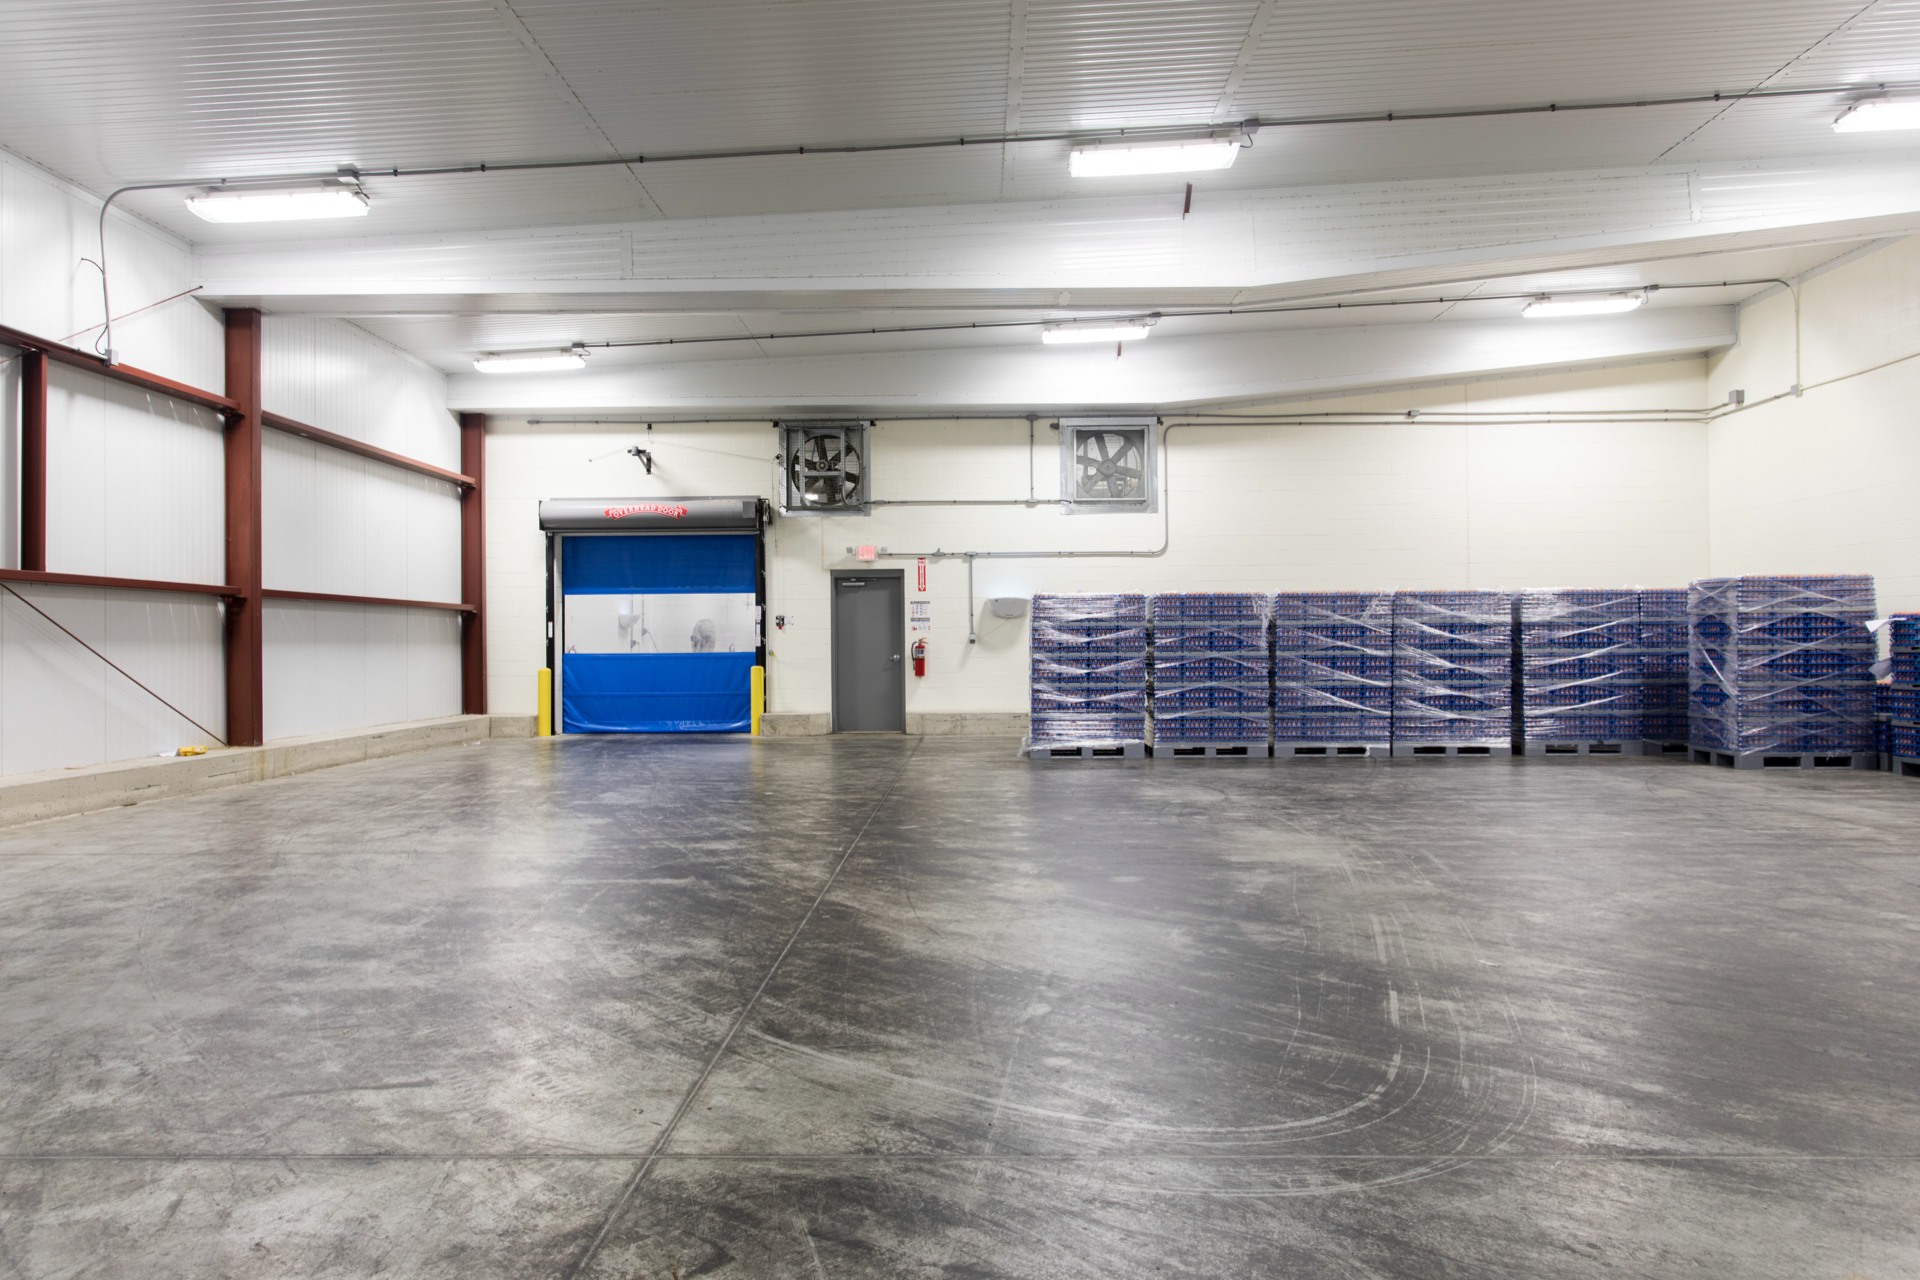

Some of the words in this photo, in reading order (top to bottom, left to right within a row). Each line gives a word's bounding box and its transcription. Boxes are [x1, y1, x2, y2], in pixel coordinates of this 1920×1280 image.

[613, 505, 656, 517] OVERHEAD
[657, 506, 679, 517] DOOR
[859, 546, 875, 559] EXIT
